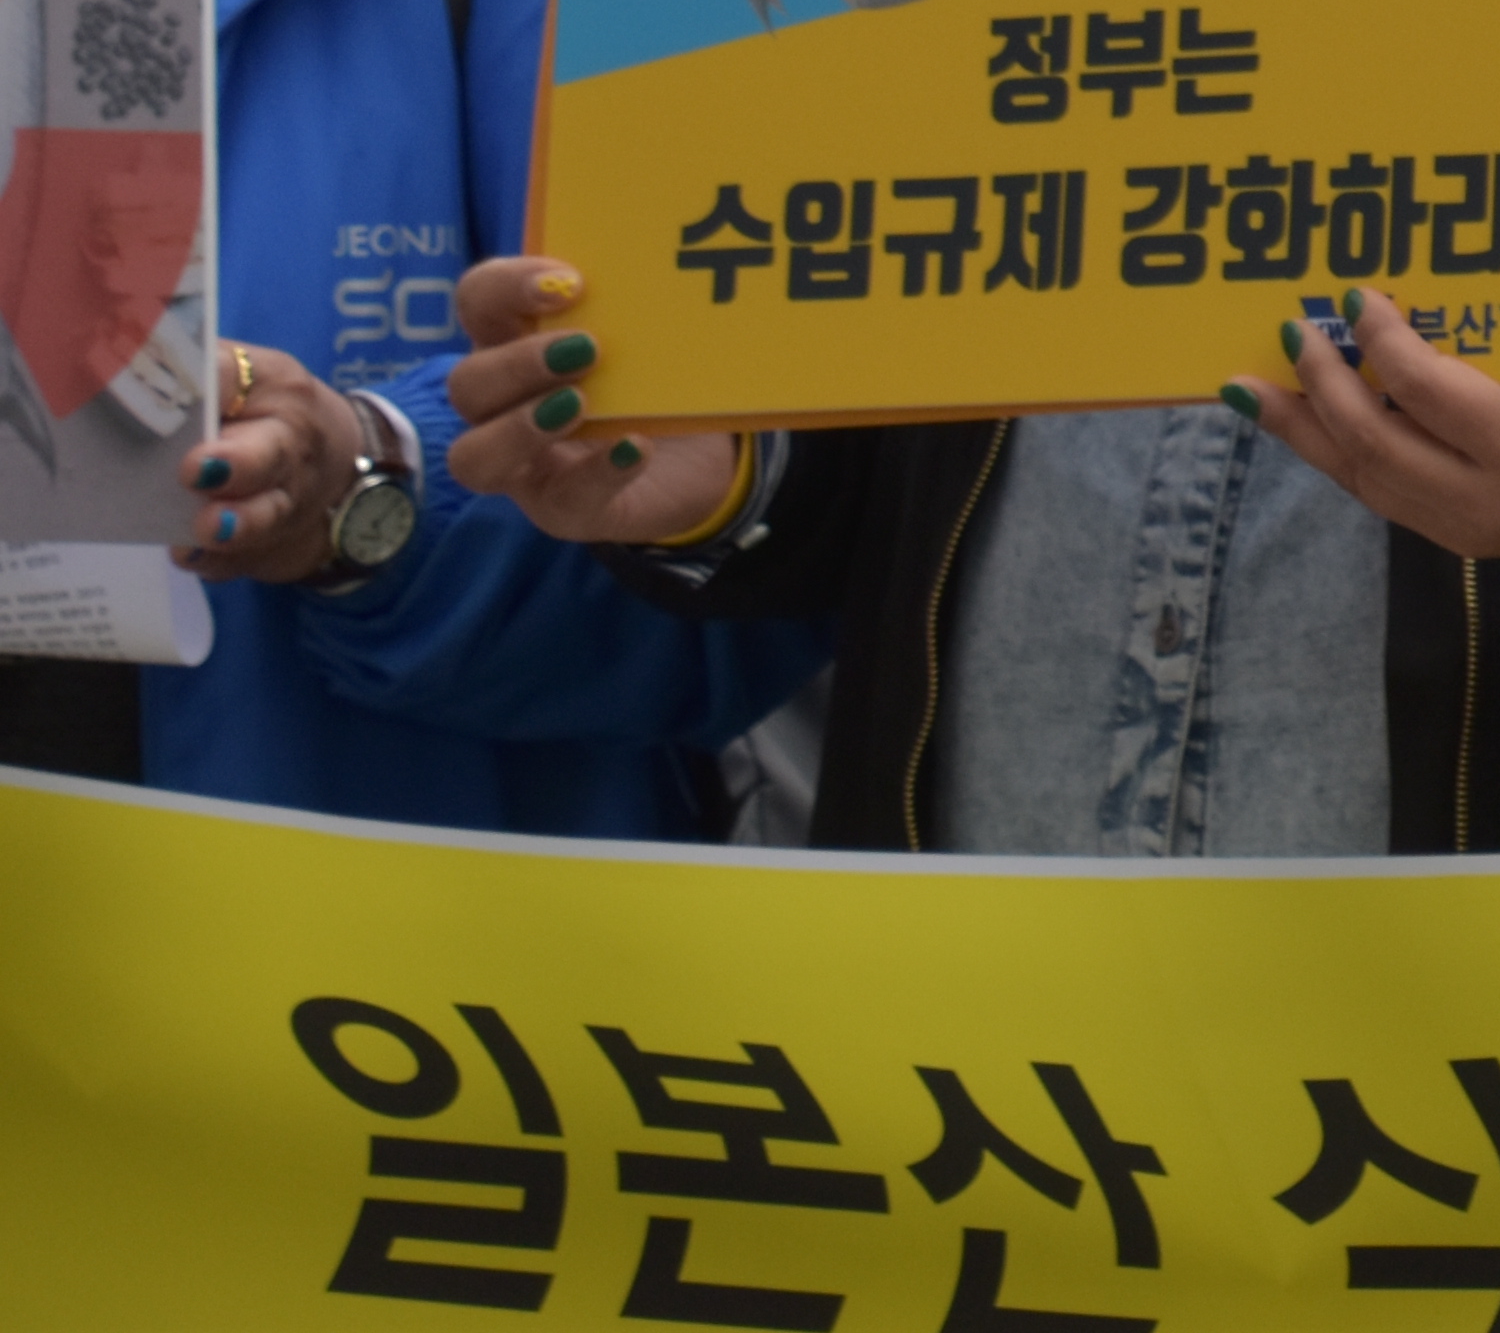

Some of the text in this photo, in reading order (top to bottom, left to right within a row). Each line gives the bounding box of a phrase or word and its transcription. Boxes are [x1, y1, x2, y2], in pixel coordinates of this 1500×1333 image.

[987, 6, 1260, 124] 정부는
[675, 168, 1088, 304] 수입규제
[289, 993, 1170, 1333] 일본산
